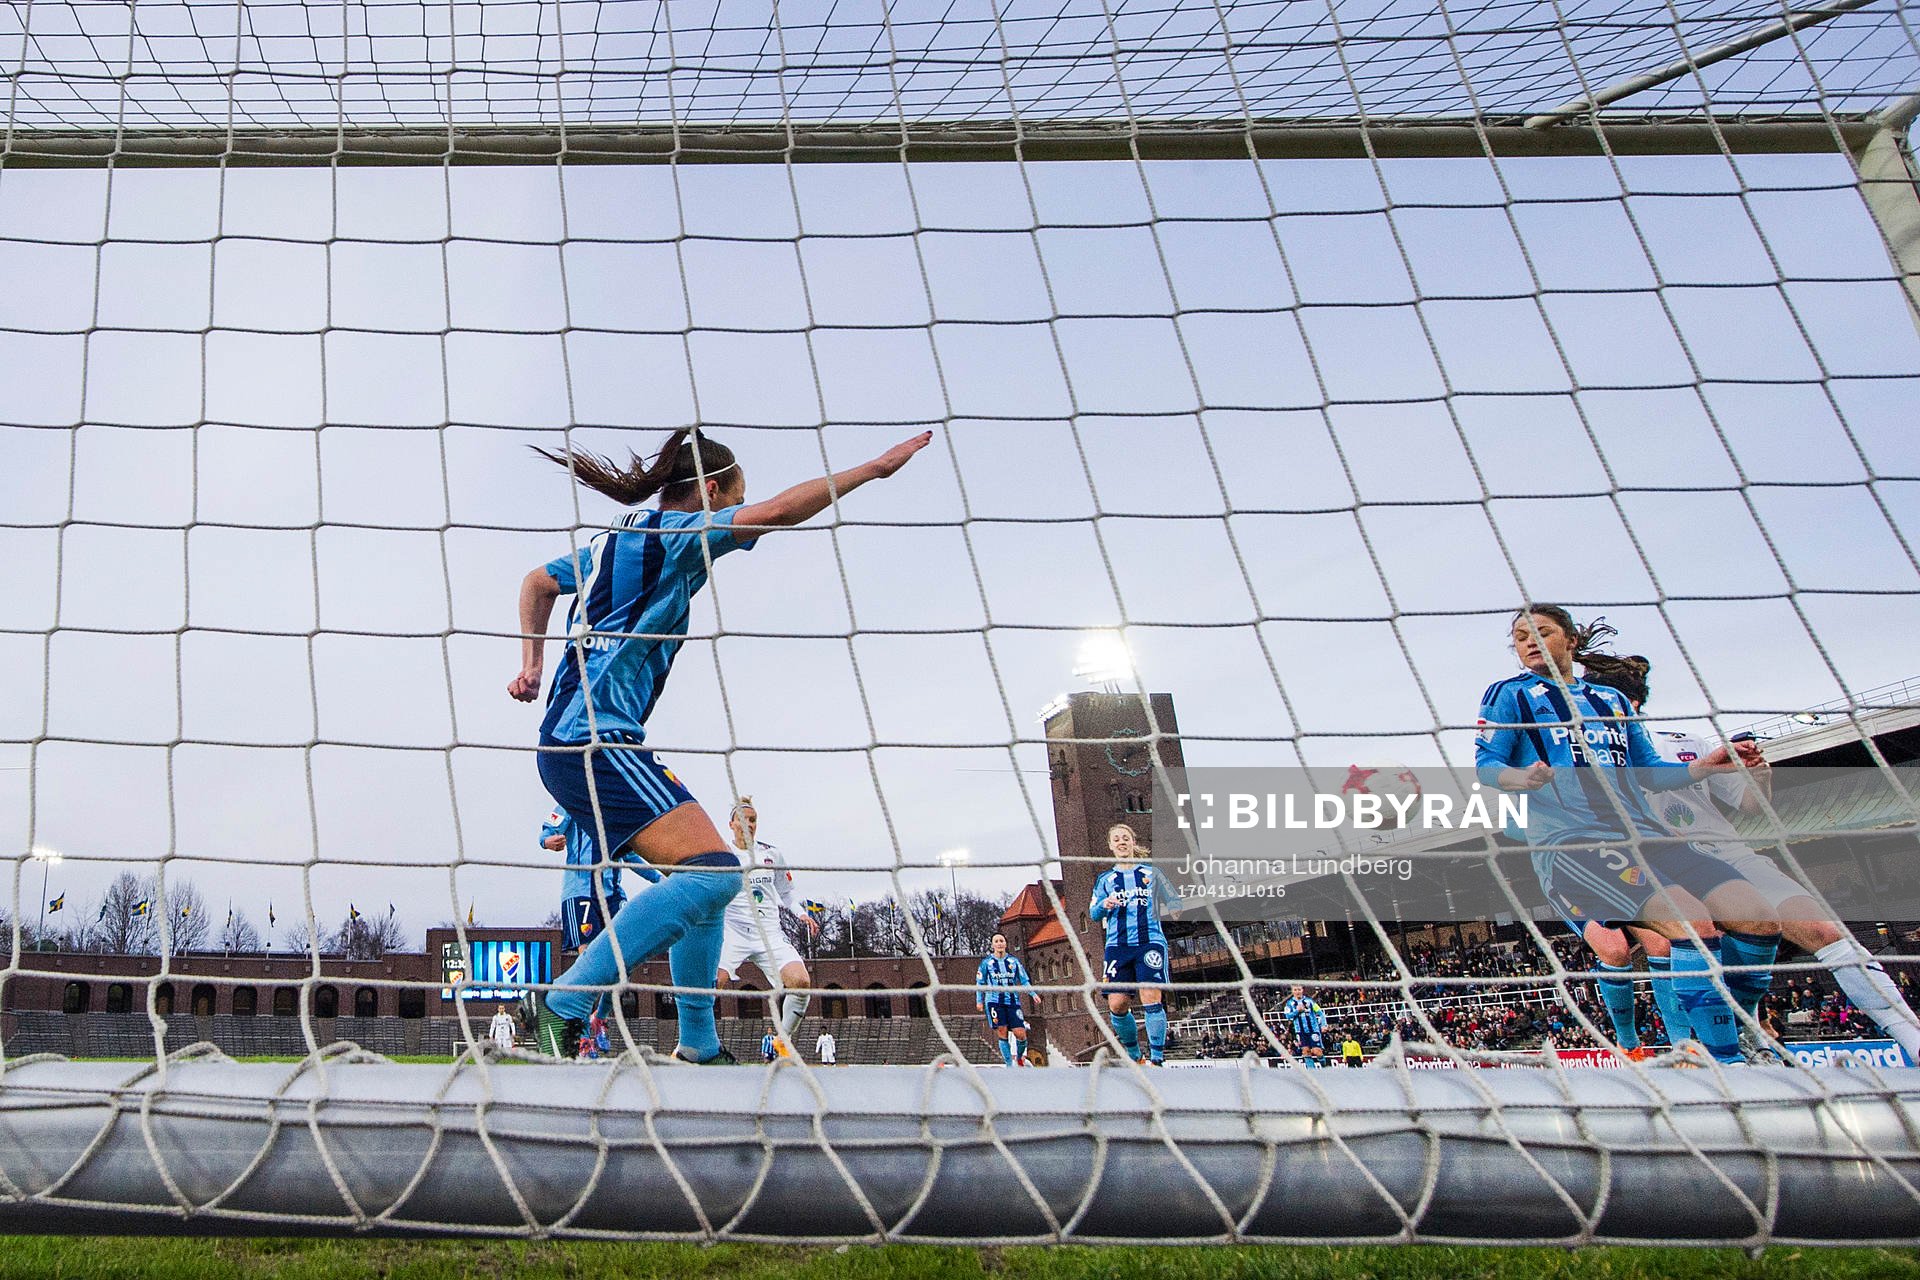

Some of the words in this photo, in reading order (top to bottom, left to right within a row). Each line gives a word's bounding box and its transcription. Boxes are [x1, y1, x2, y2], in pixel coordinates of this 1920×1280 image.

[579, 901, 591, 924] 7
[991, 1007, 998, 1019] 6
[1714, 1014, 1733, 1026] DIF
[1794, 1043, 1905, 1068] ostnord
